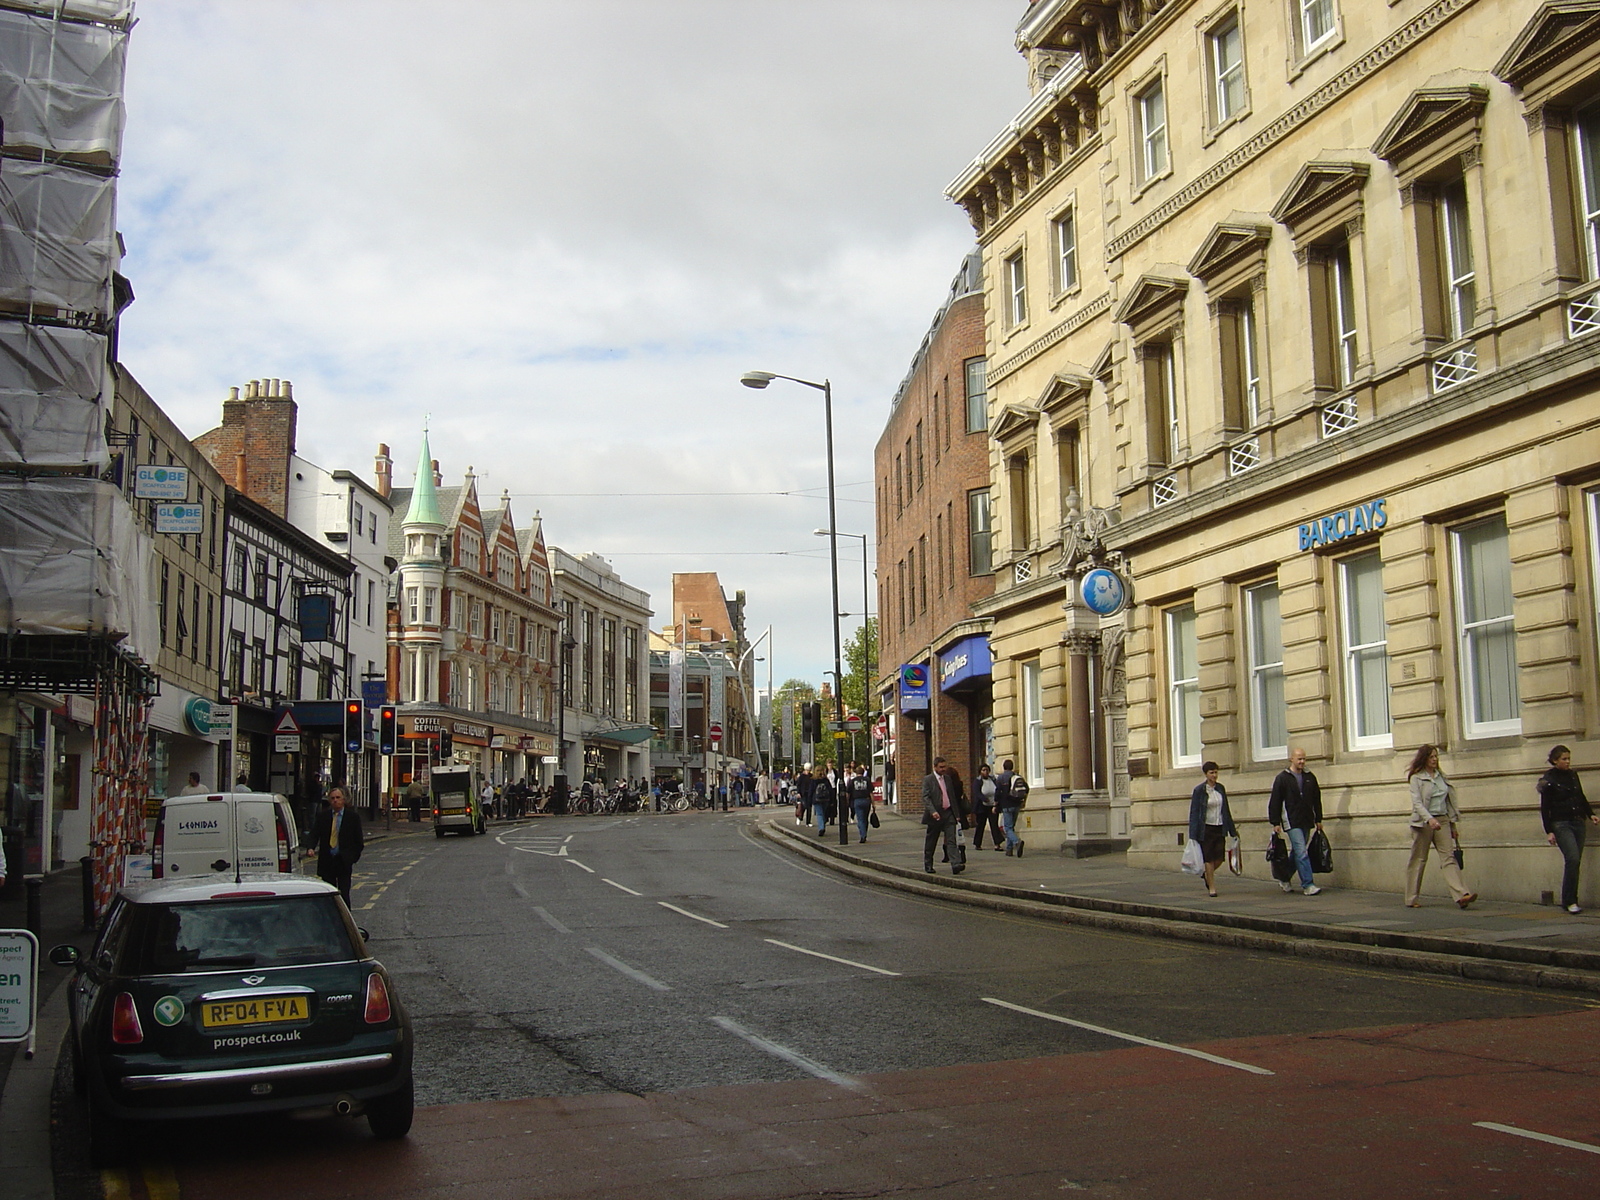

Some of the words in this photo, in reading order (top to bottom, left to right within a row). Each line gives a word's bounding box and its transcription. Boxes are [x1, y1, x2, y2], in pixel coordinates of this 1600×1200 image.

[138, 469, 185, 482] GLOBE
[159, 506, 200, 518] GLOBE
[1298, 498, 1386, 551] BARCLAYS
[414, 717, 440, 725] COFFEE
[414, 724, 441, 732] REPUB
[453, 722, 469, 735] COFFEE
[179, 820, 218, 830] LEONIDAS
[0, 946, 22, 954] spect
[0, 973, 21, 986] en
[327, 994, 353, 1004] COOPER
[211, 1003, 259, 1023] RF04
[264, 999, 300, 1019] FVA
[213, 1030, 302, 1049] prospect.co.uk
